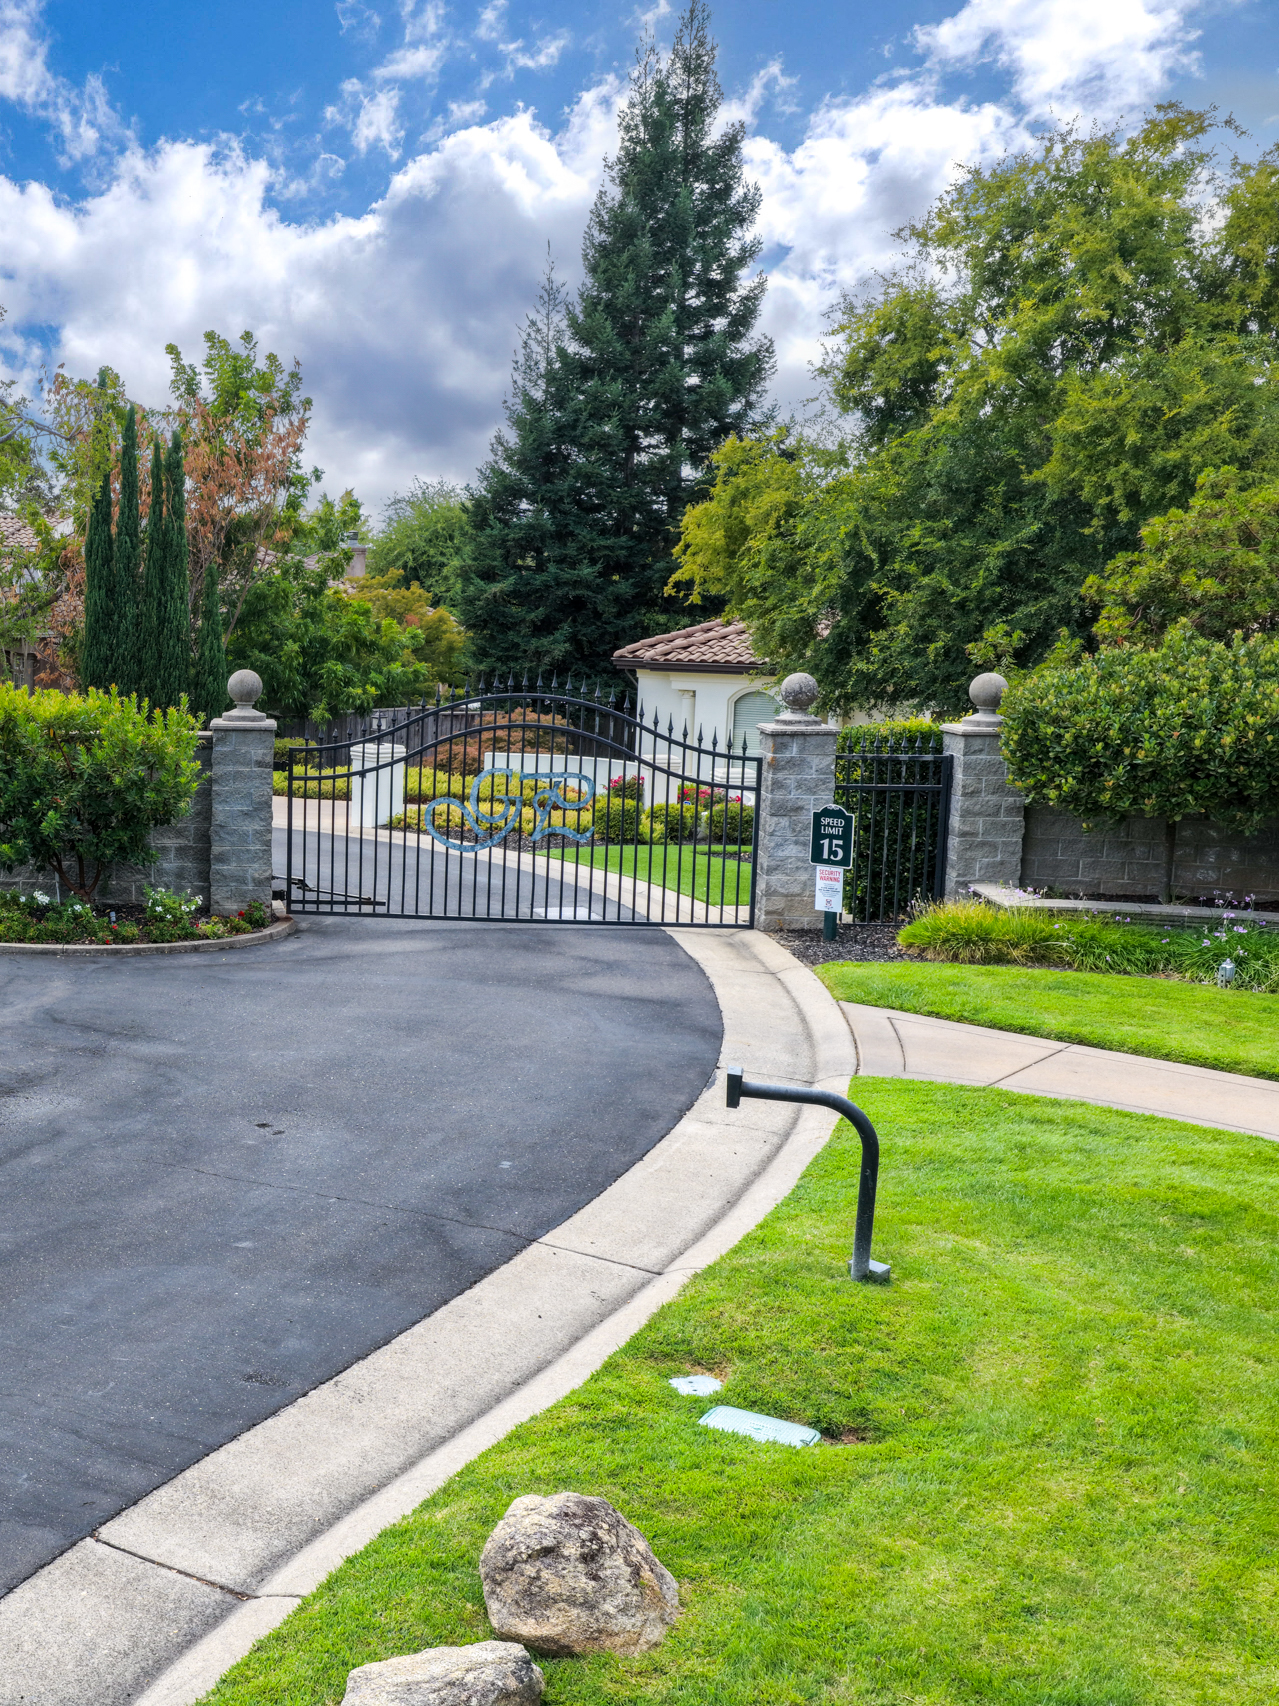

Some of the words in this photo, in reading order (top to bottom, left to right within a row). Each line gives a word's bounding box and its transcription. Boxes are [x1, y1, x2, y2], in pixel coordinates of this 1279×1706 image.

[821, 817, 844, 826] SPEED
[821, 826, 843, 835] LIMIT
[820, 838, 844, 861] 15
[819, 875, 840, 883] WARNING
